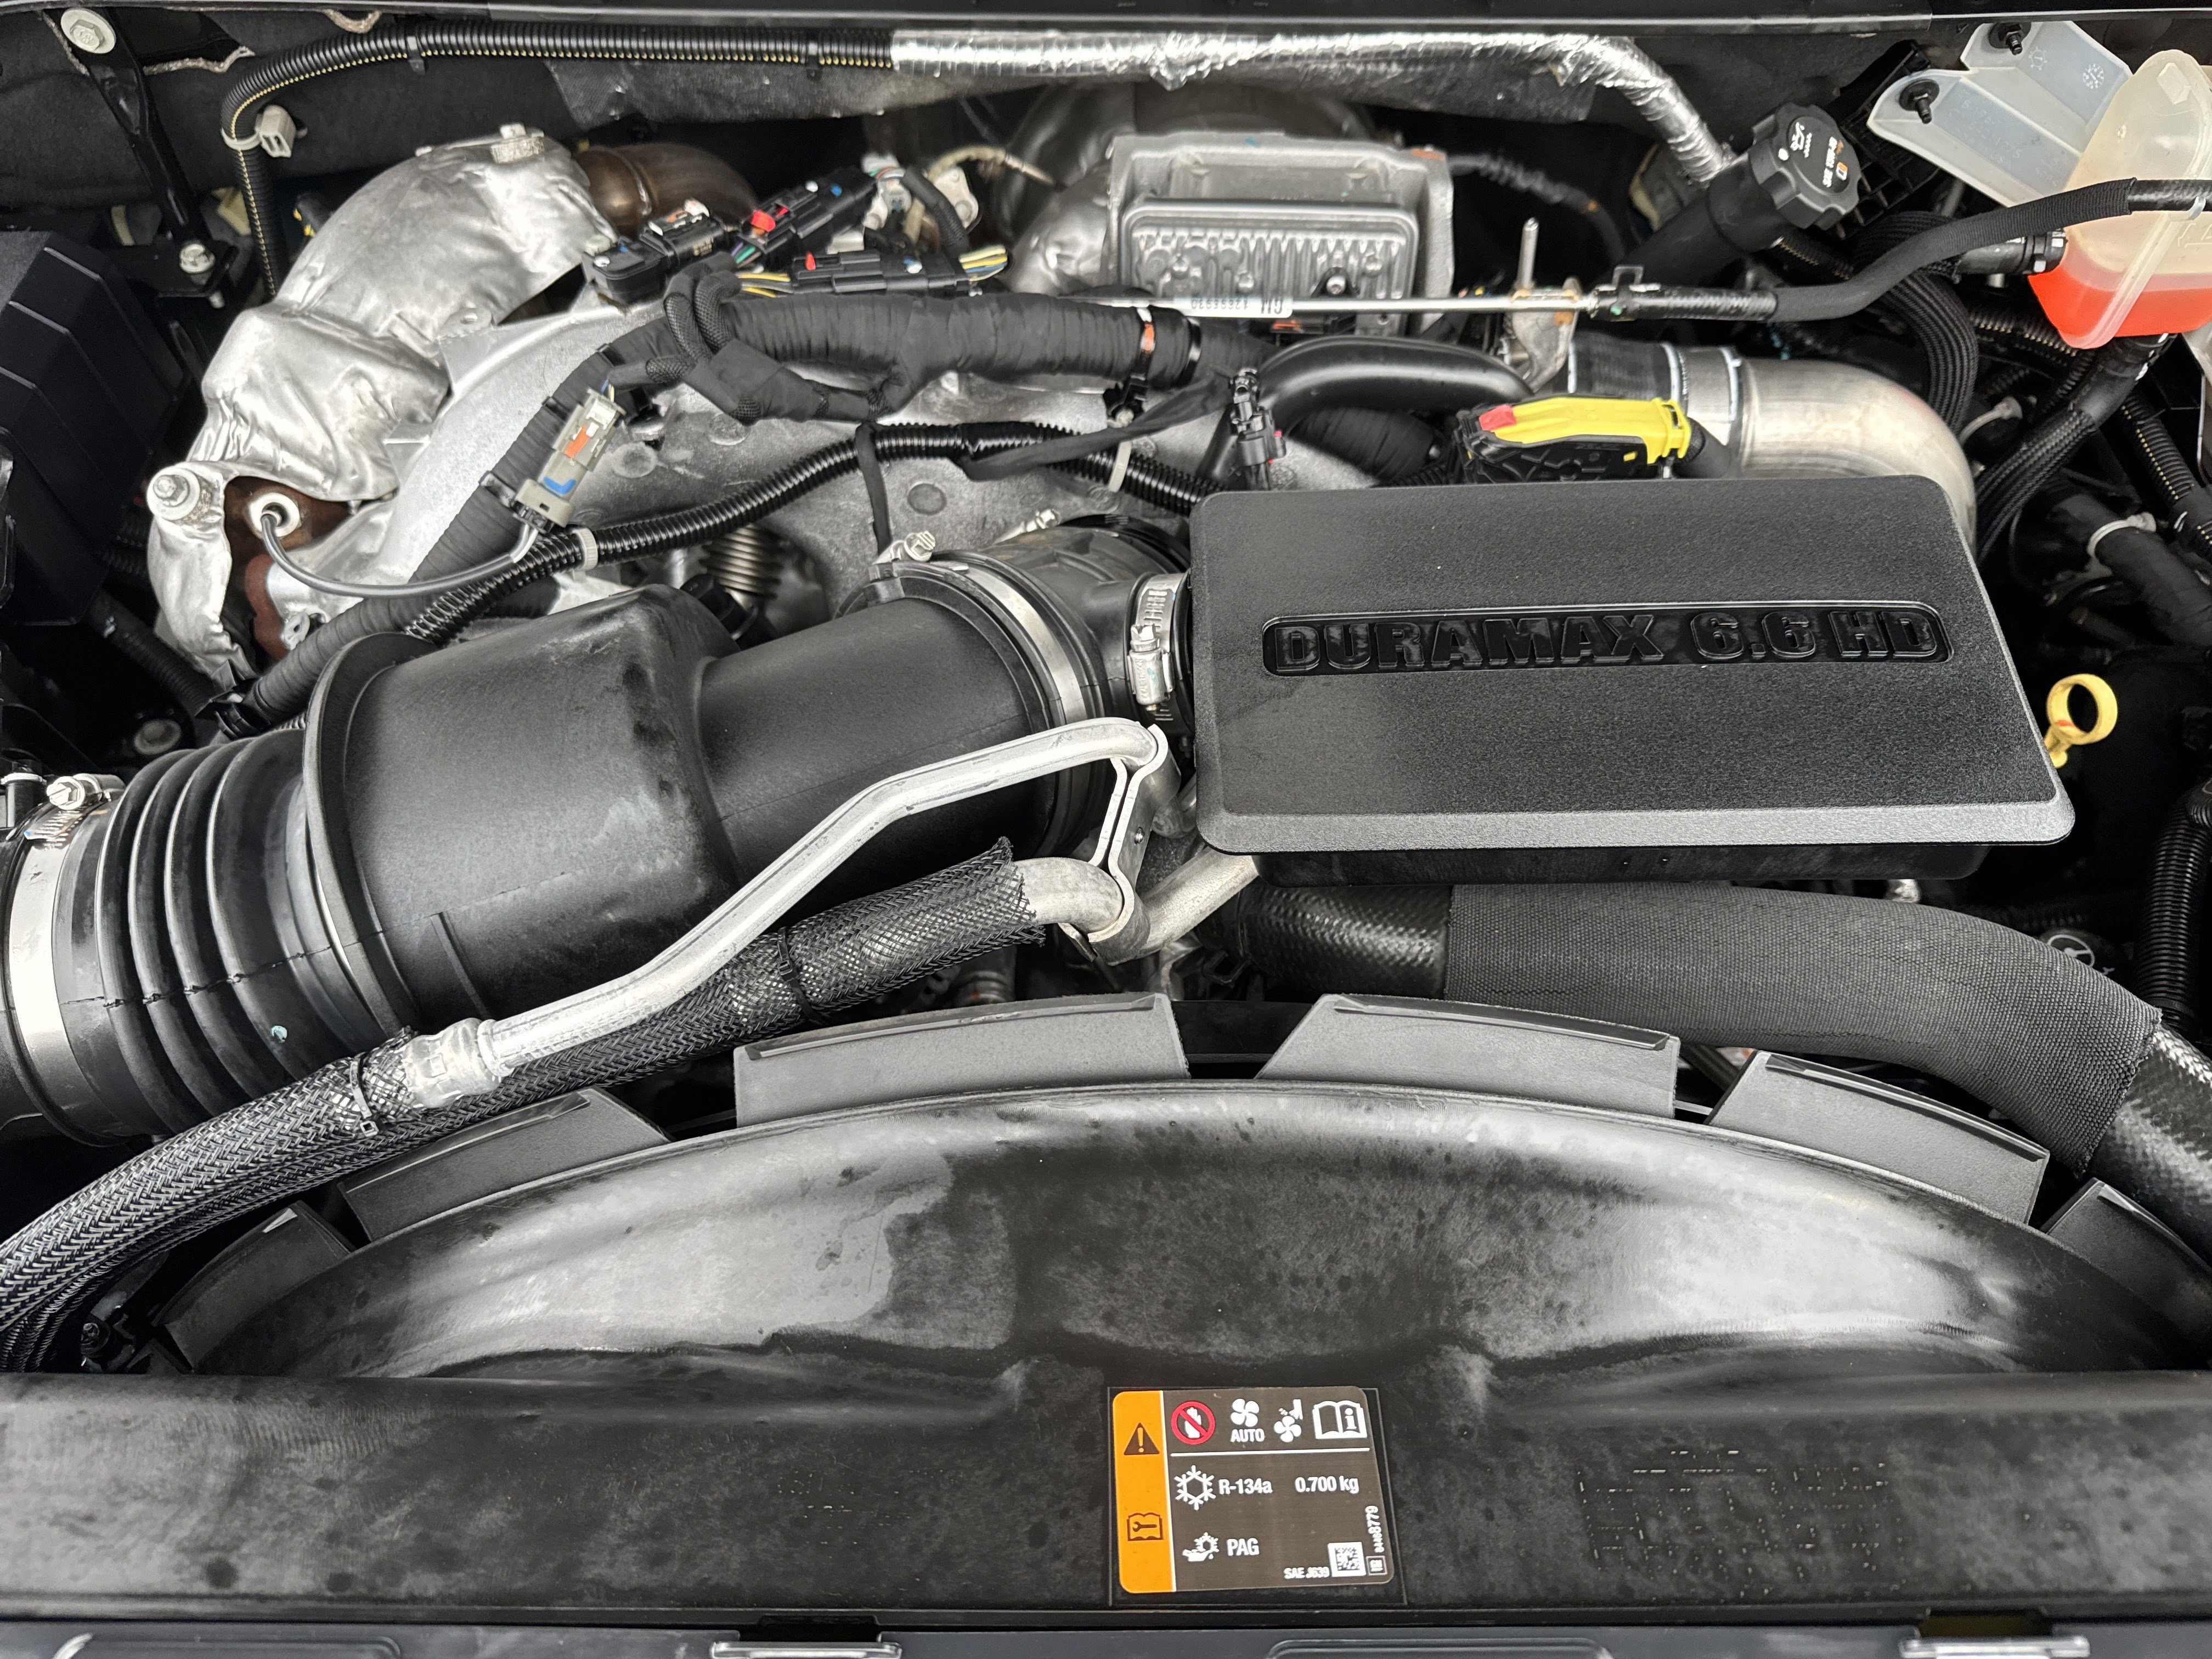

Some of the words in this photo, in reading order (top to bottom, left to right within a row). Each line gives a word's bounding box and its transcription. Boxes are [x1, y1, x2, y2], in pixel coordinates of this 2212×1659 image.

[1276, 614, 1664, 670] DURAMAX
[1690, 611, 1816, 660] 6.6
[1829, 610, 1939, 659] HD
[1231, 1428, 1265, 1443] AUTO
[1218, 1478, 1273, 1495] R-134a
[1295, 1476, 1336, 1493] 0.700
[1339, 1476, 1359, 1494] kg
[1227, 1538, 1260, 1556] PAG
[1283, 1567, 1305, 1579] SAE
